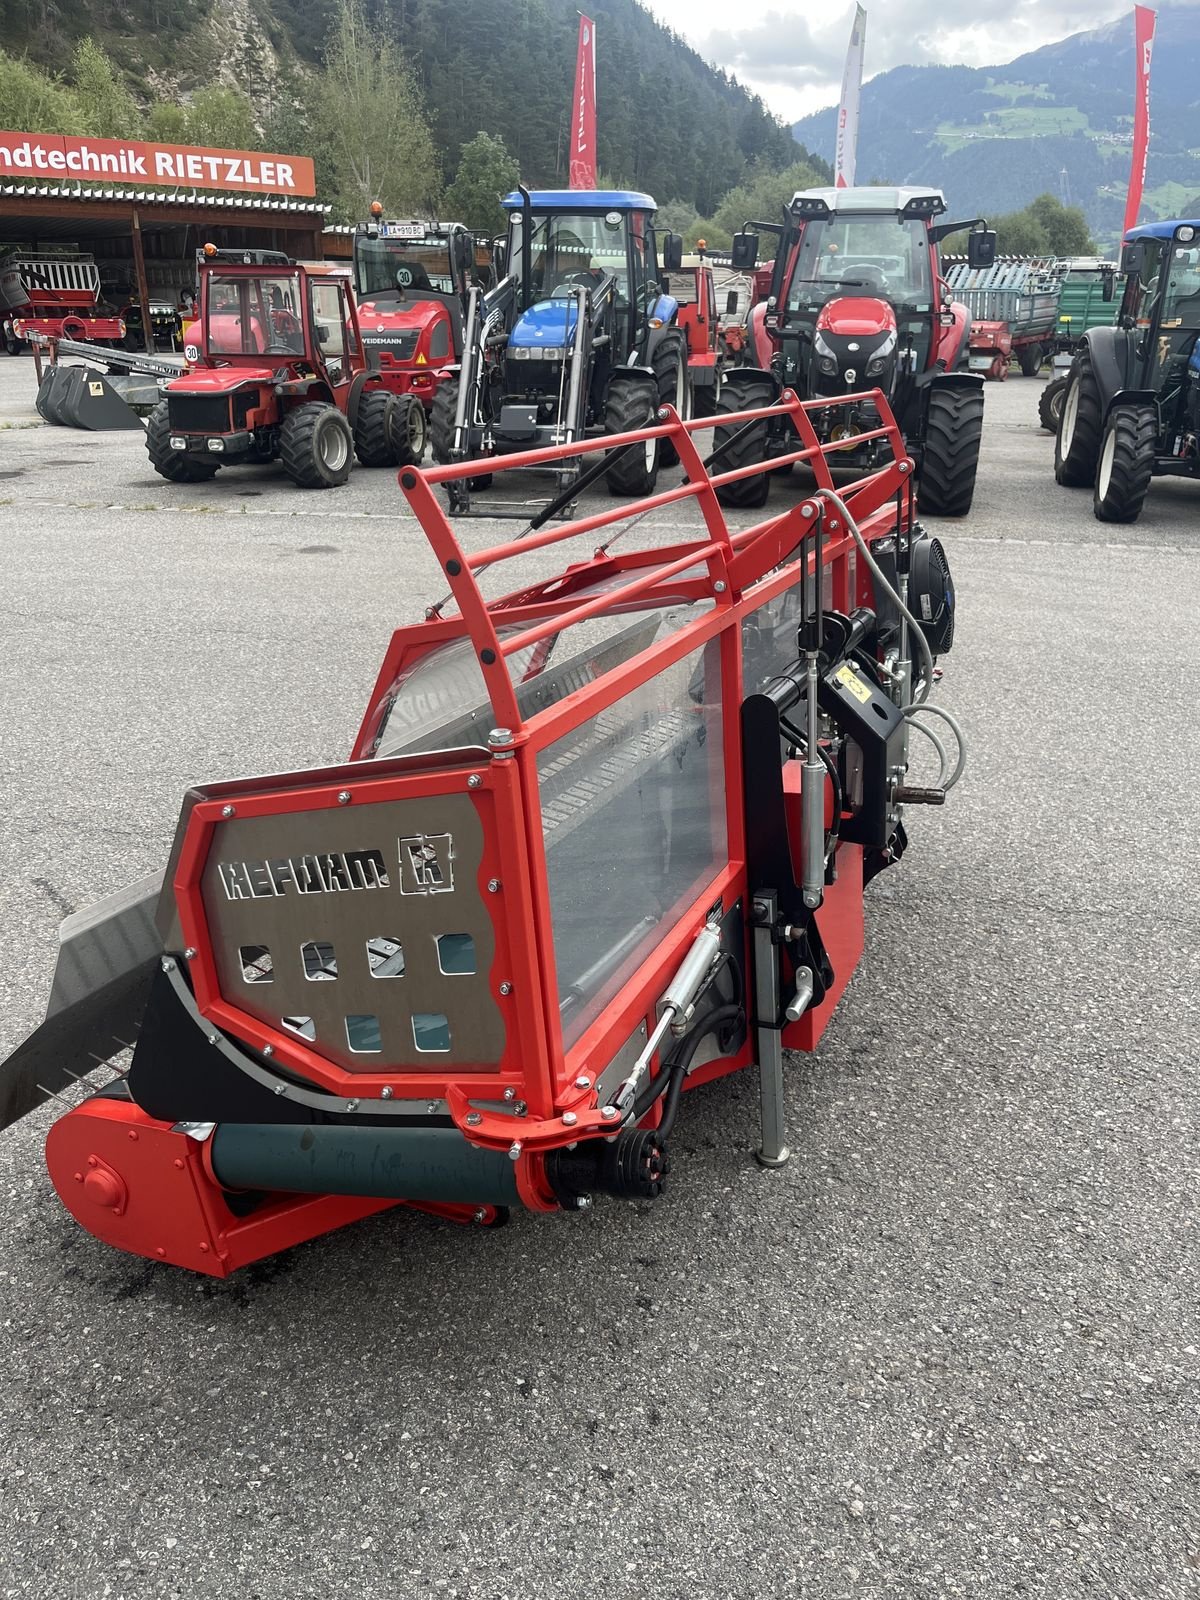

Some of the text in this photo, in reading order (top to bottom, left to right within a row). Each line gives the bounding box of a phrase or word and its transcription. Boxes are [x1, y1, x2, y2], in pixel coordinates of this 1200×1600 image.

[154, 151, 296, 187] RIETZLER
[400, 271, 410, 283] 30
[187, 347, 197, 358] 30
[218, 849, 391, 900] REFORM
